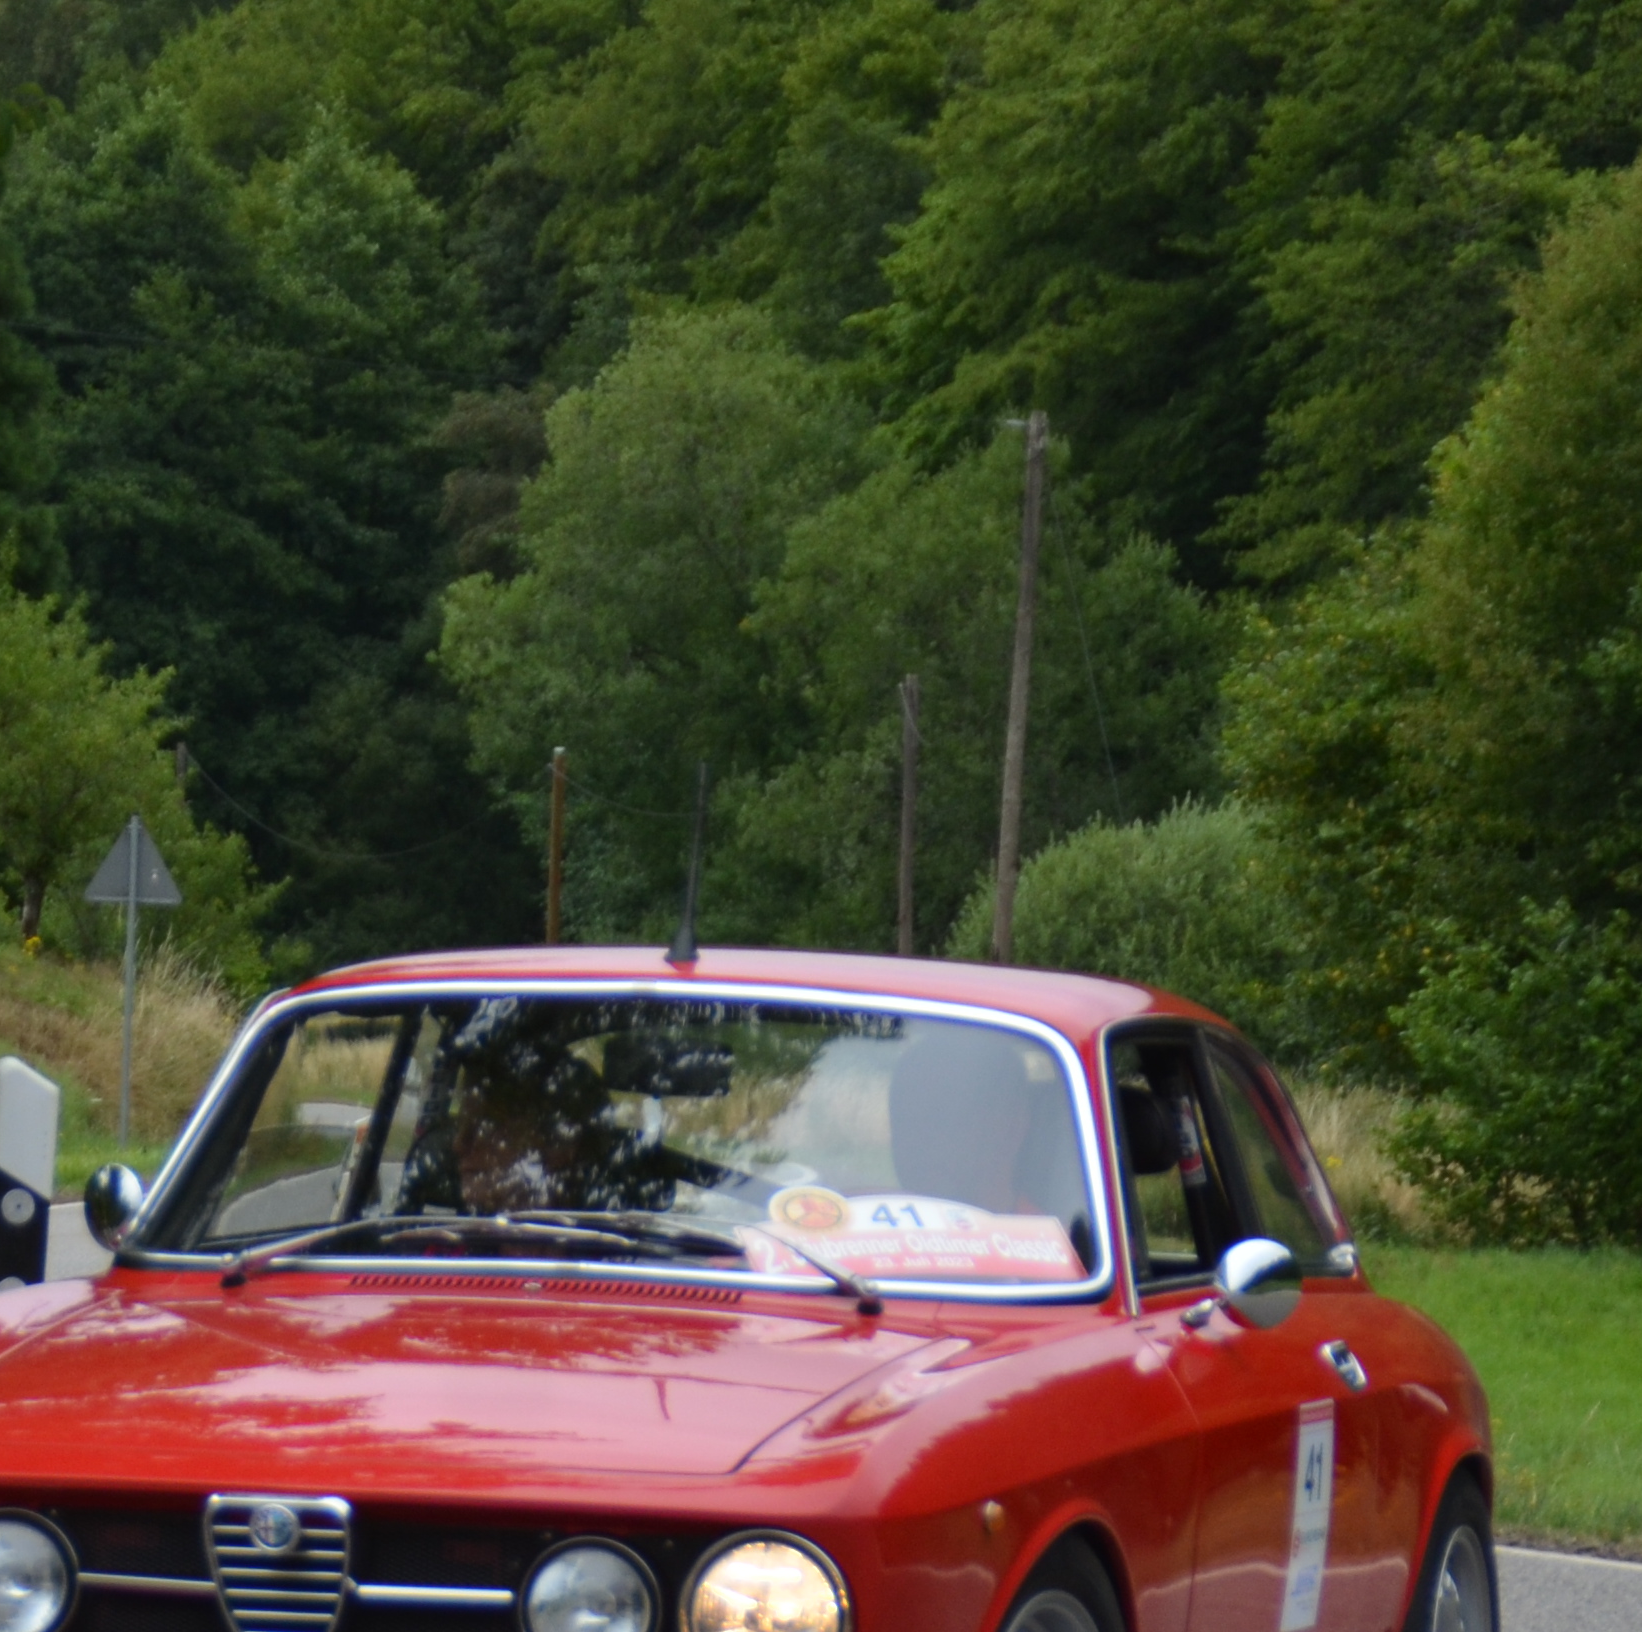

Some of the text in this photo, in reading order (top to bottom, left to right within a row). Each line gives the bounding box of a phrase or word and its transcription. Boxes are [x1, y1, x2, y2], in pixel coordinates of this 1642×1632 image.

[871, 1202, 925, 1229] 41
[904, 1232, 990, 1256] Oldtimer
[991, 1232, 1069, 1265] Classic
[1303, 1441, 1324, 1502] 41
